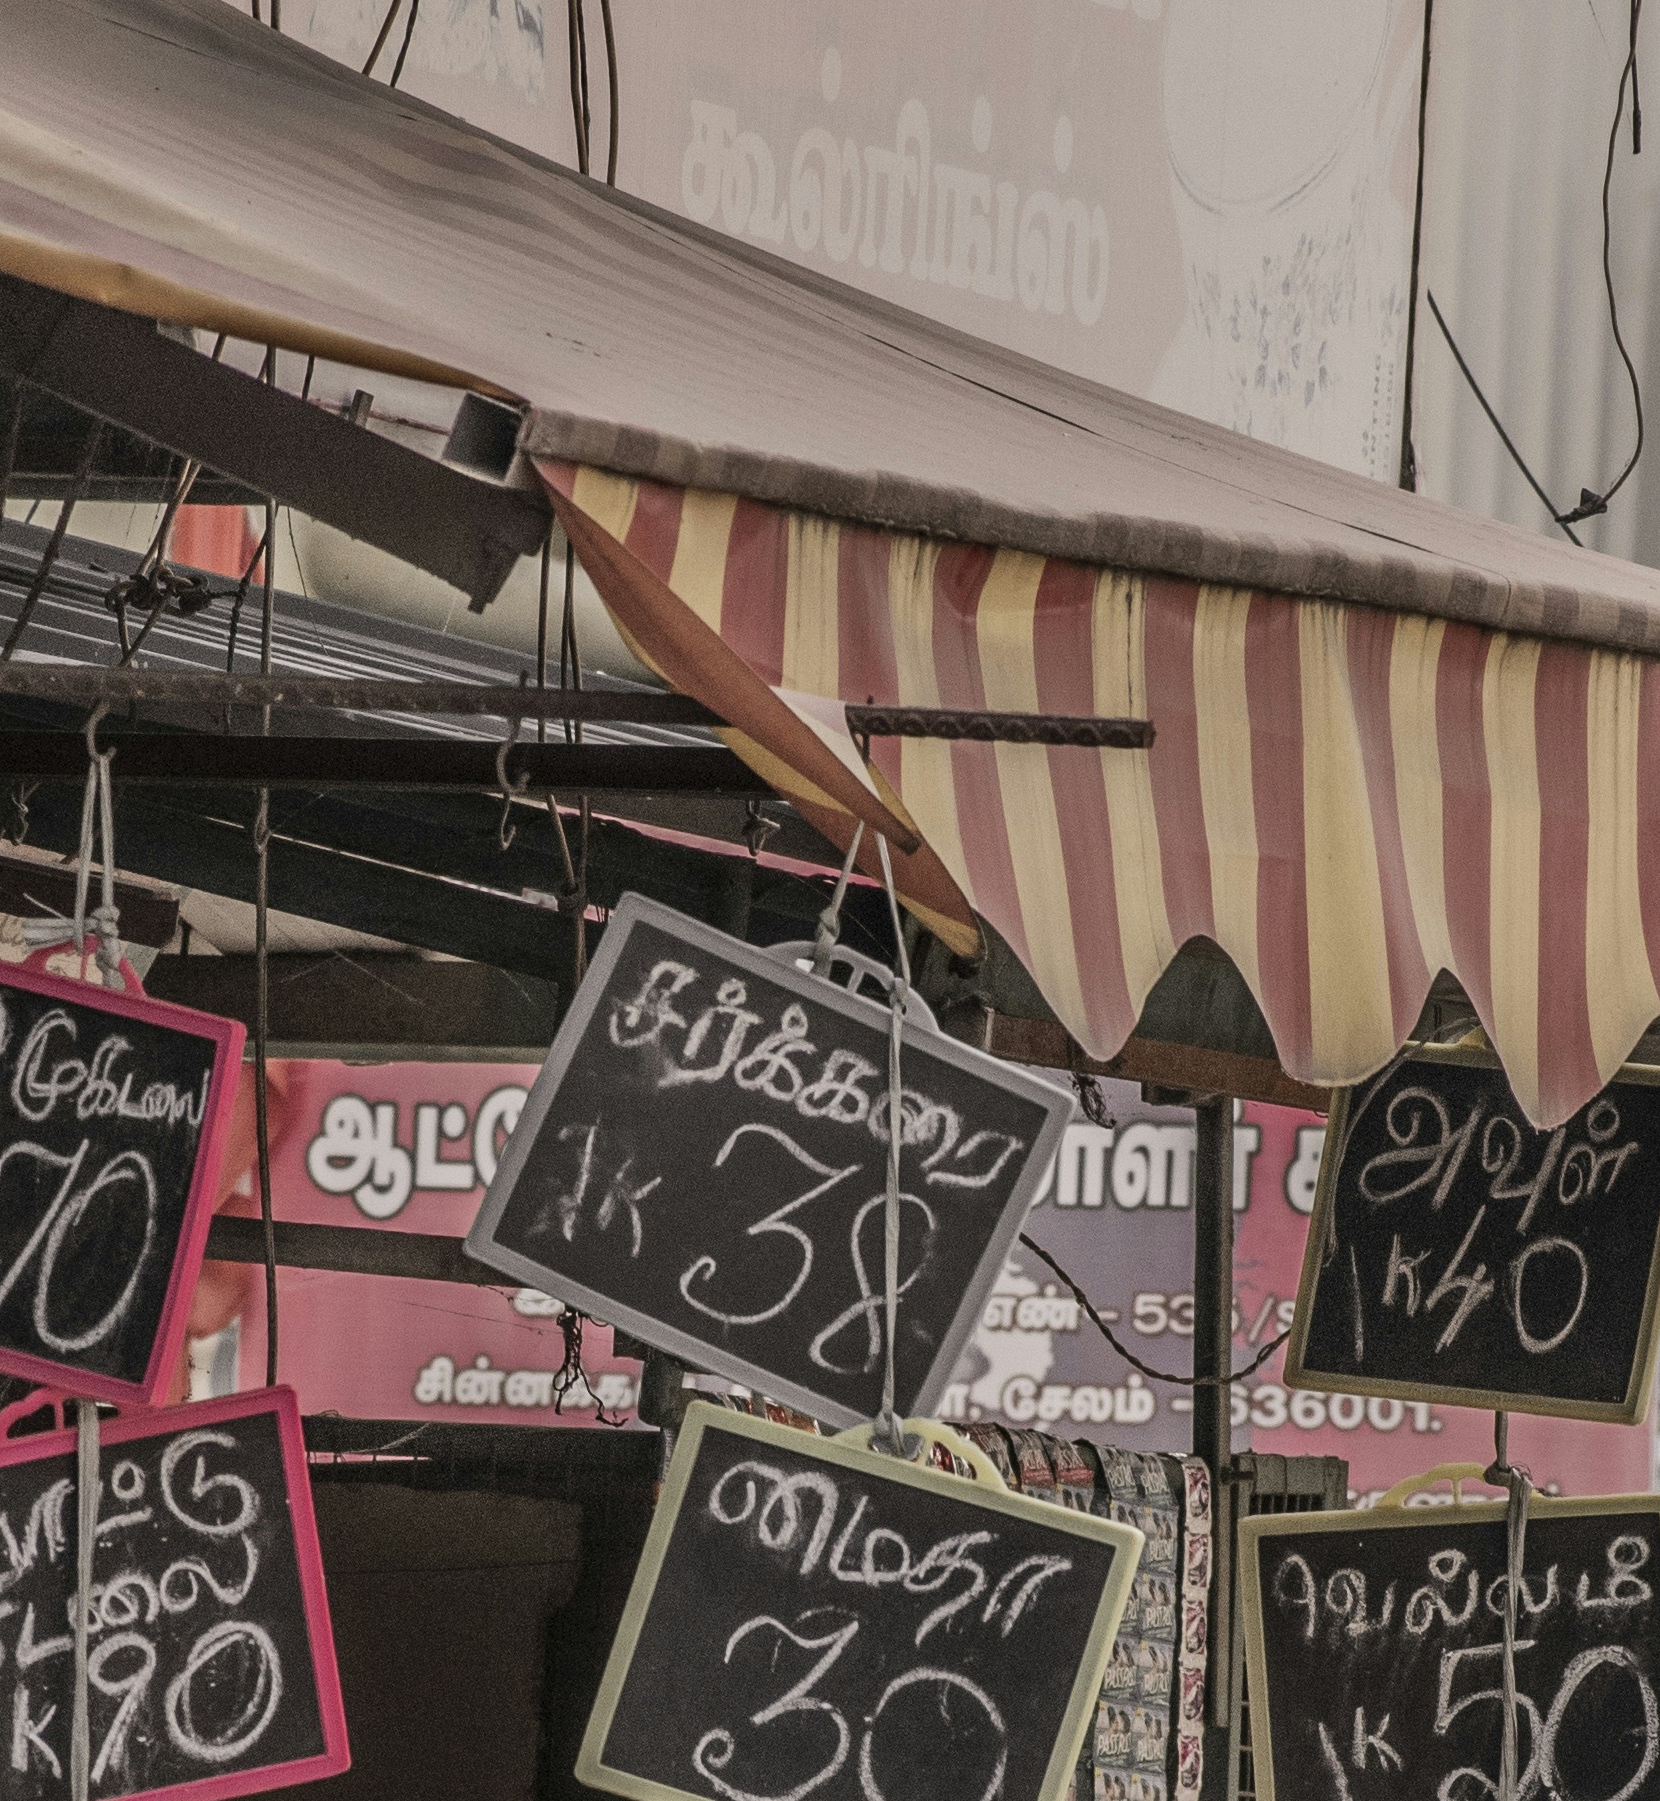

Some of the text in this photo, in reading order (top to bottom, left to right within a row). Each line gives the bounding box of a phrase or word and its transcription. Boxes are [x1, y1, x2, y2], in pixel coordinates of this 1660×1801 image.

[679, 1122, 937, 1374] 38
[1425, 1206, 1589, 1354] 40
[1001, 1373, 1155, 1423] சேலம்
[708, 1460, 1072, 1647] மைதா
[89, 1620, 282, 1784] 90
